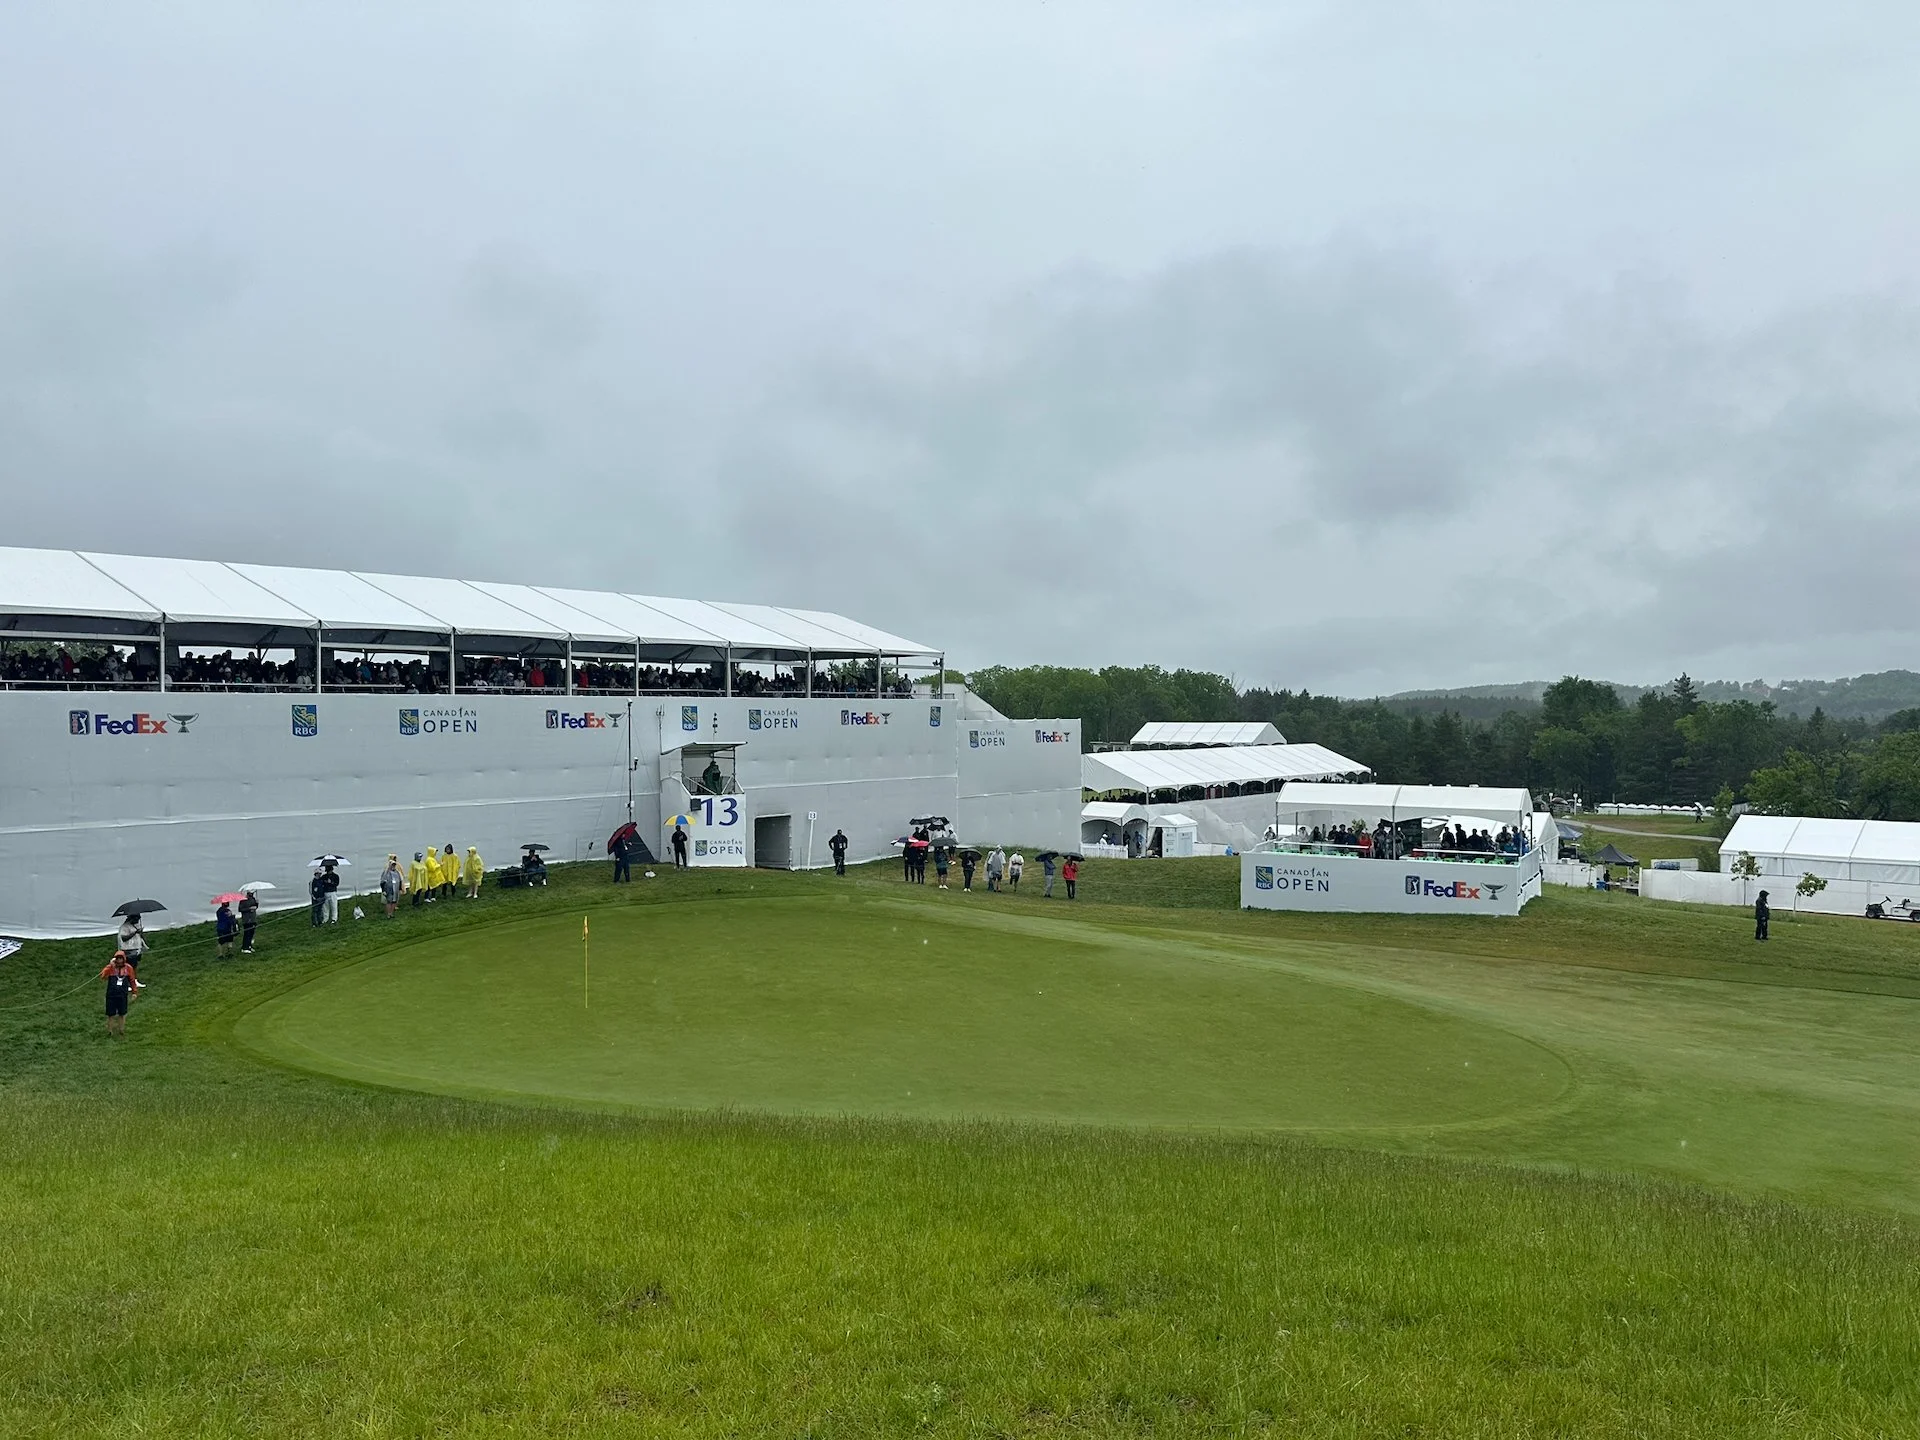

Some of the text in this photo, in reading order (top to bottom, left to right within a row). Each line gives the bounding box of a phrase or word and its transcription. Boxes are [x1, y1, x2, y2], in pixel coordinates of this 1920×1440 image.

[423, 707, 477, 718] CANADIAN
[763, 708, 798, 717] CANADIAN
[851, 712, 880, 725] FedEx
[95, 713, 168, 735] FedEx
[423, 719, 477, 733] OPEN
[561, 712, 606, 729] FedEx
[763, 718, 798, 728] OPEN
[295, 727, 316, 735] RBC
[1042, 731, 1063, 743] FedEx
[980, 737, 1005, 747] OPEN
[700, 797, 739, 826] 13
[709, 846, 743, 855] OPEN
[1277, 867, 1329, 878] CANADIAN
[1277, 877, 1329, 892] OPEN
[1423, 879, 1481, 899] FedEx
